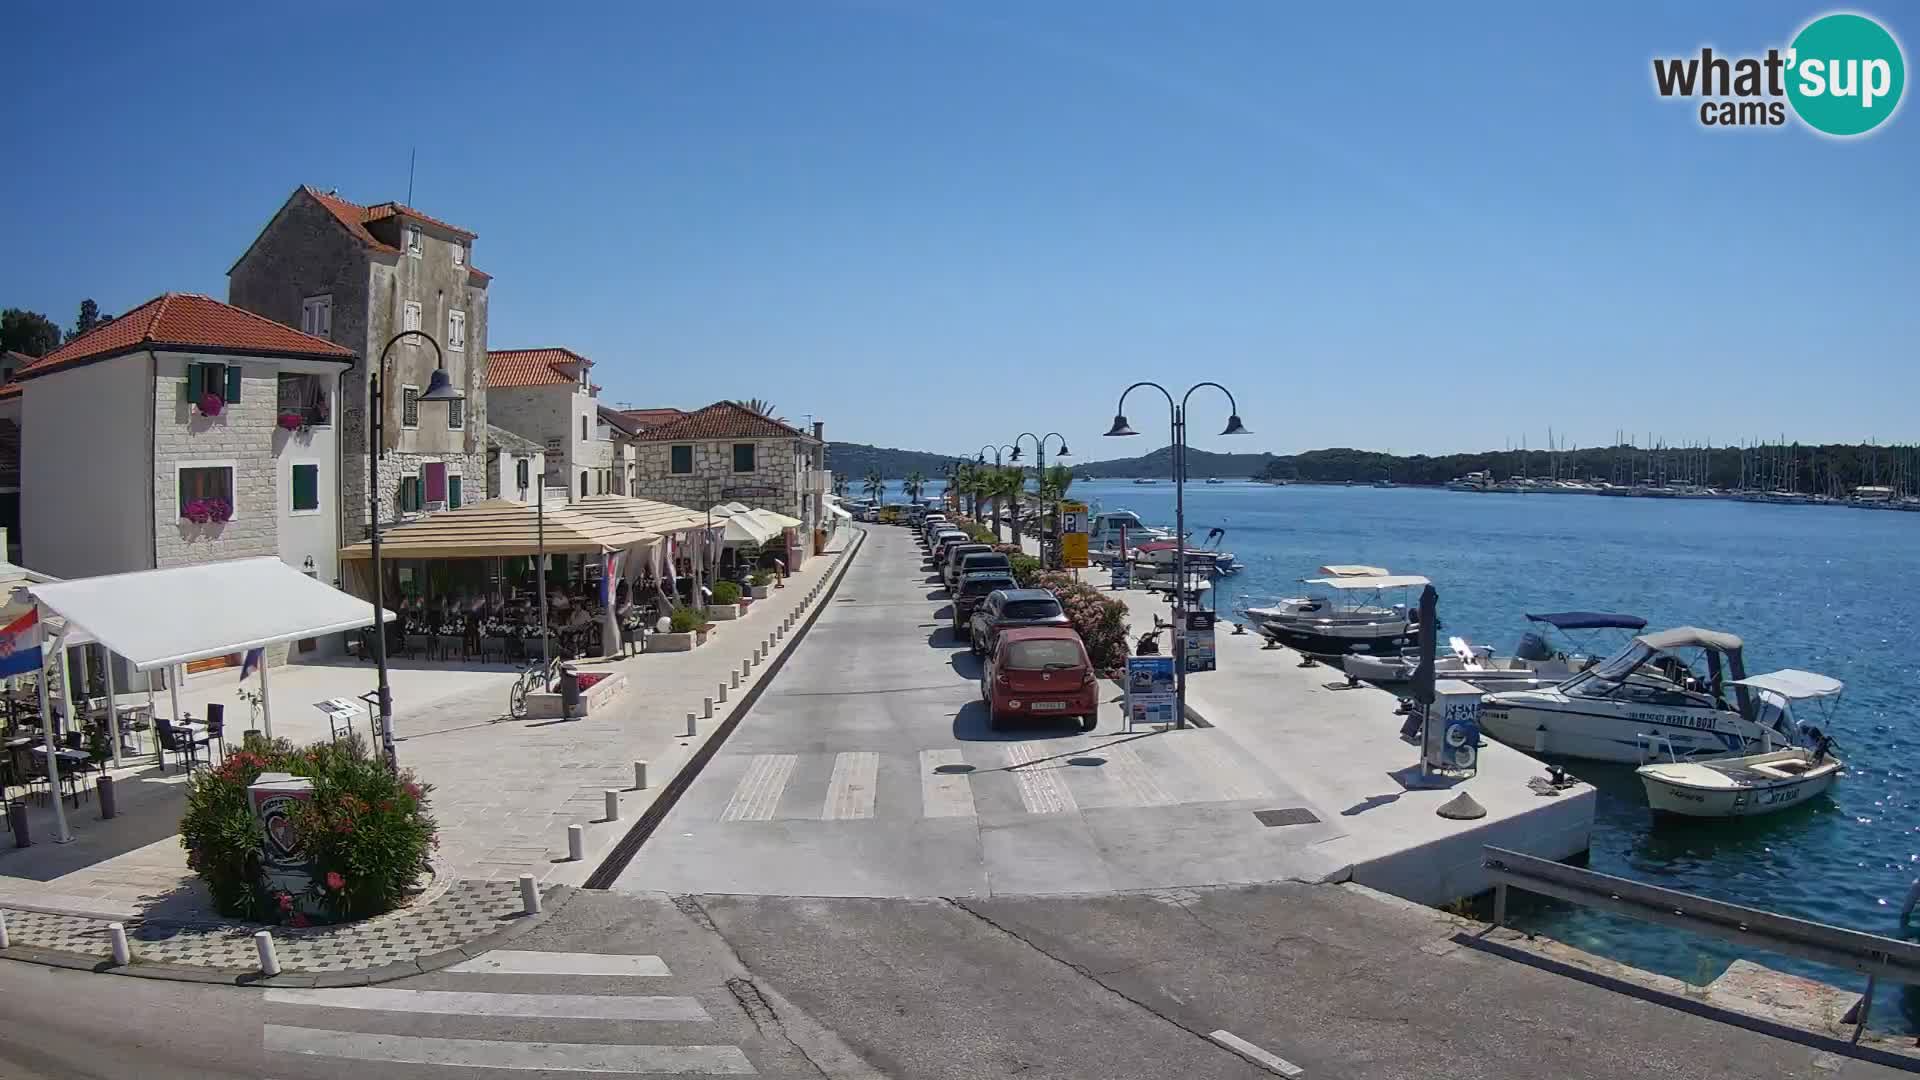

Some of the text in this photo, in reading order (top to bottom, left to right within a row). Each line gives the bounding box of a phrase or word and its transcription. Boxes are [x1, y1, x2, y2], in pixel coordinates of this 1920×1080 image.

[1065, 514, 1075, 531] P
[1446, 703, 1479, 713] RENT
[1446, 712, 1453, 720] A
[1455, 711, 1477, 720] BOAT
[1666, 715, 1689, 726] RENT
[1696, 717, 1718, 729] BOAT
